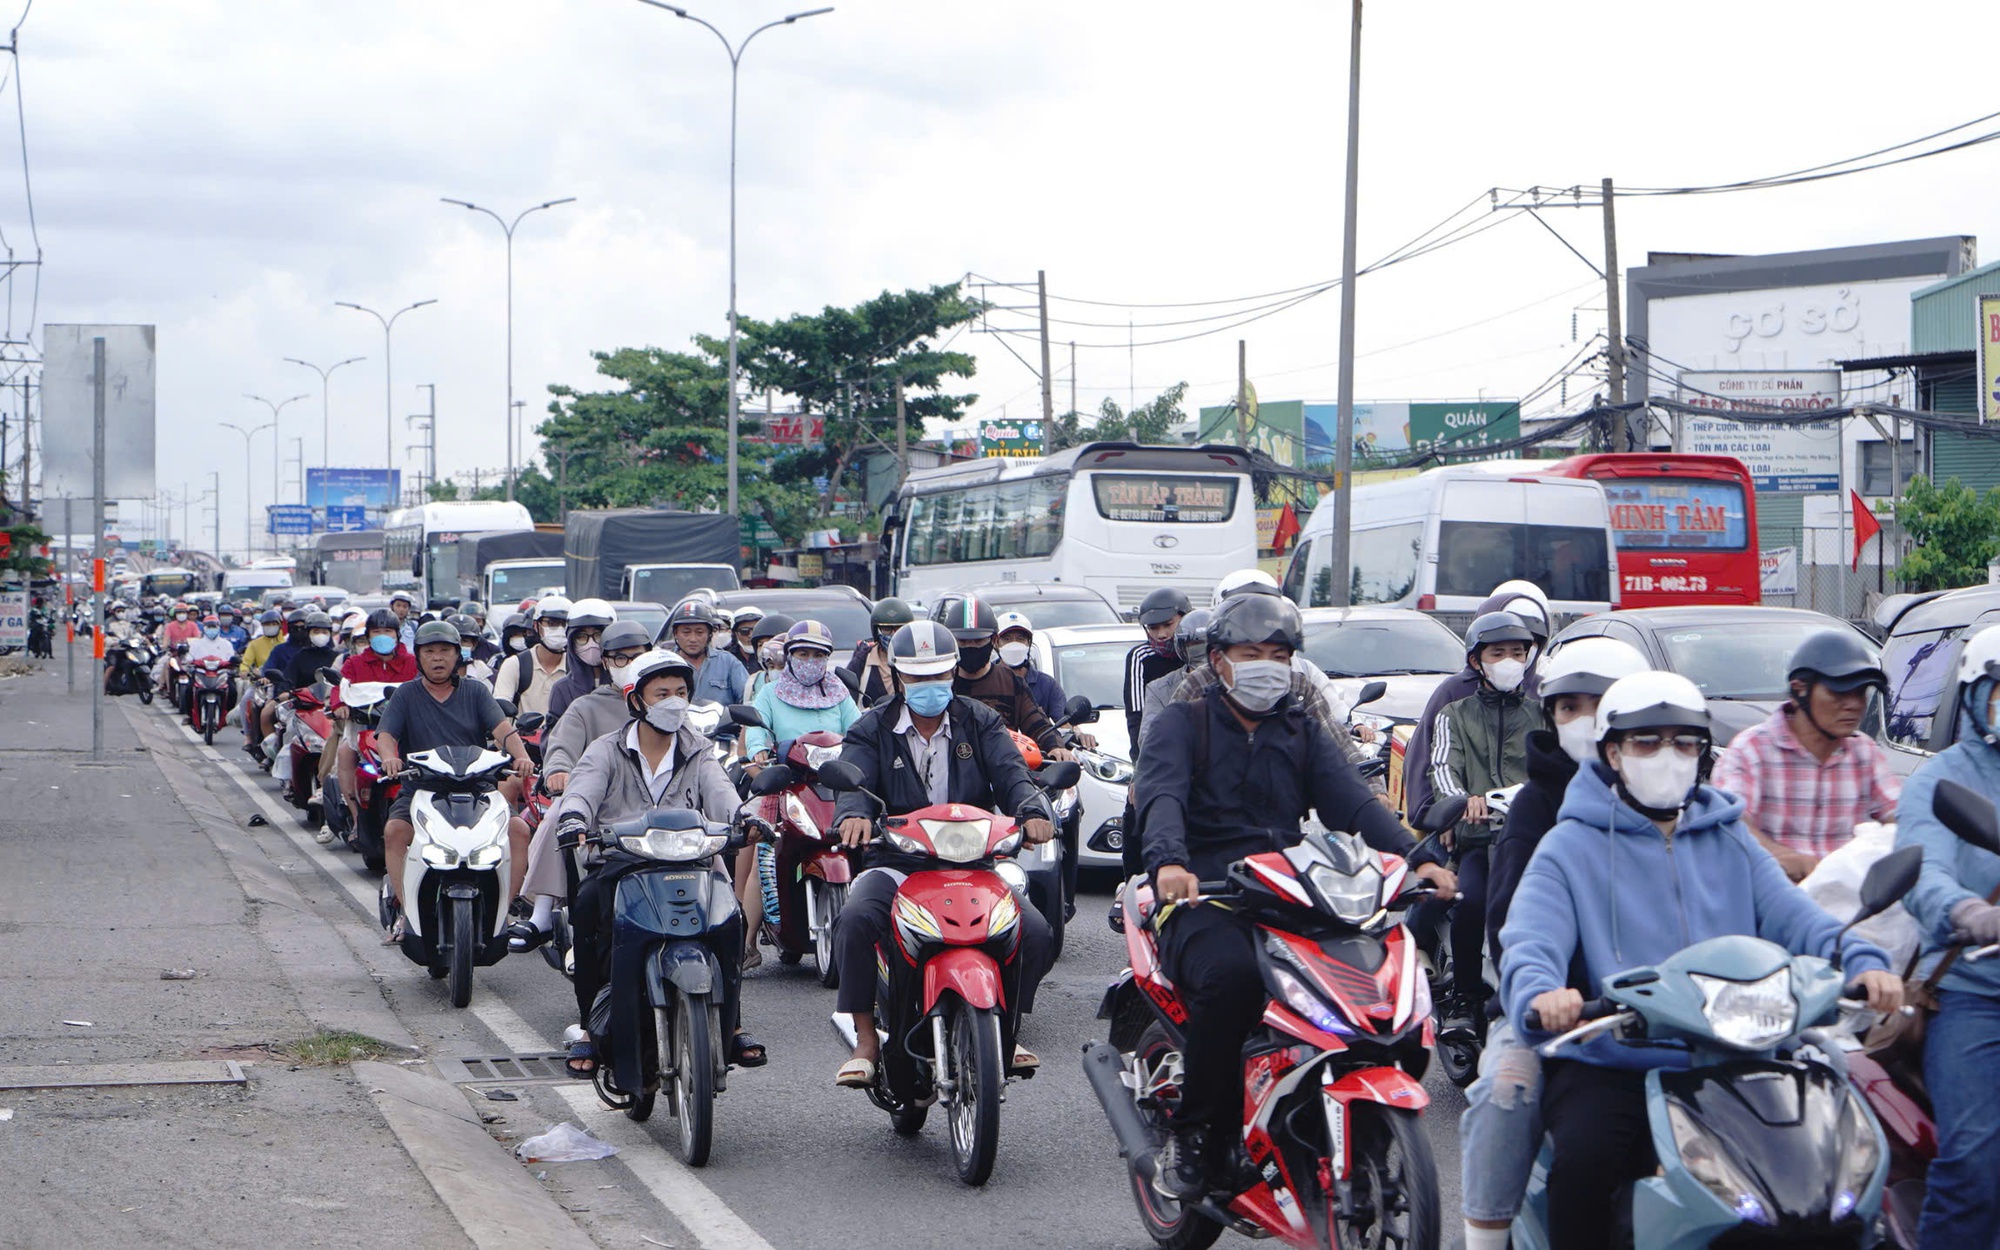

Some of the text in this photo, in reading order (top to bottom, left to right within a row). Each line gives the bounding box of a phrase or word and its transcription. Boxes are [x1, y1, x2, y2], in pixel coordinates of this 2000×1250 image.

[1445, 409, 1487, 428] QUÁN
[1694, 443, 1712, 452] TÔN
[1730, 443, 1749, 452] CÁC
[1752, 444, 1771, 454] LOẠI
[1752, 464, 1771, 475] LOẠI
[1609, 497, 1727, 532] MINH TÂM
